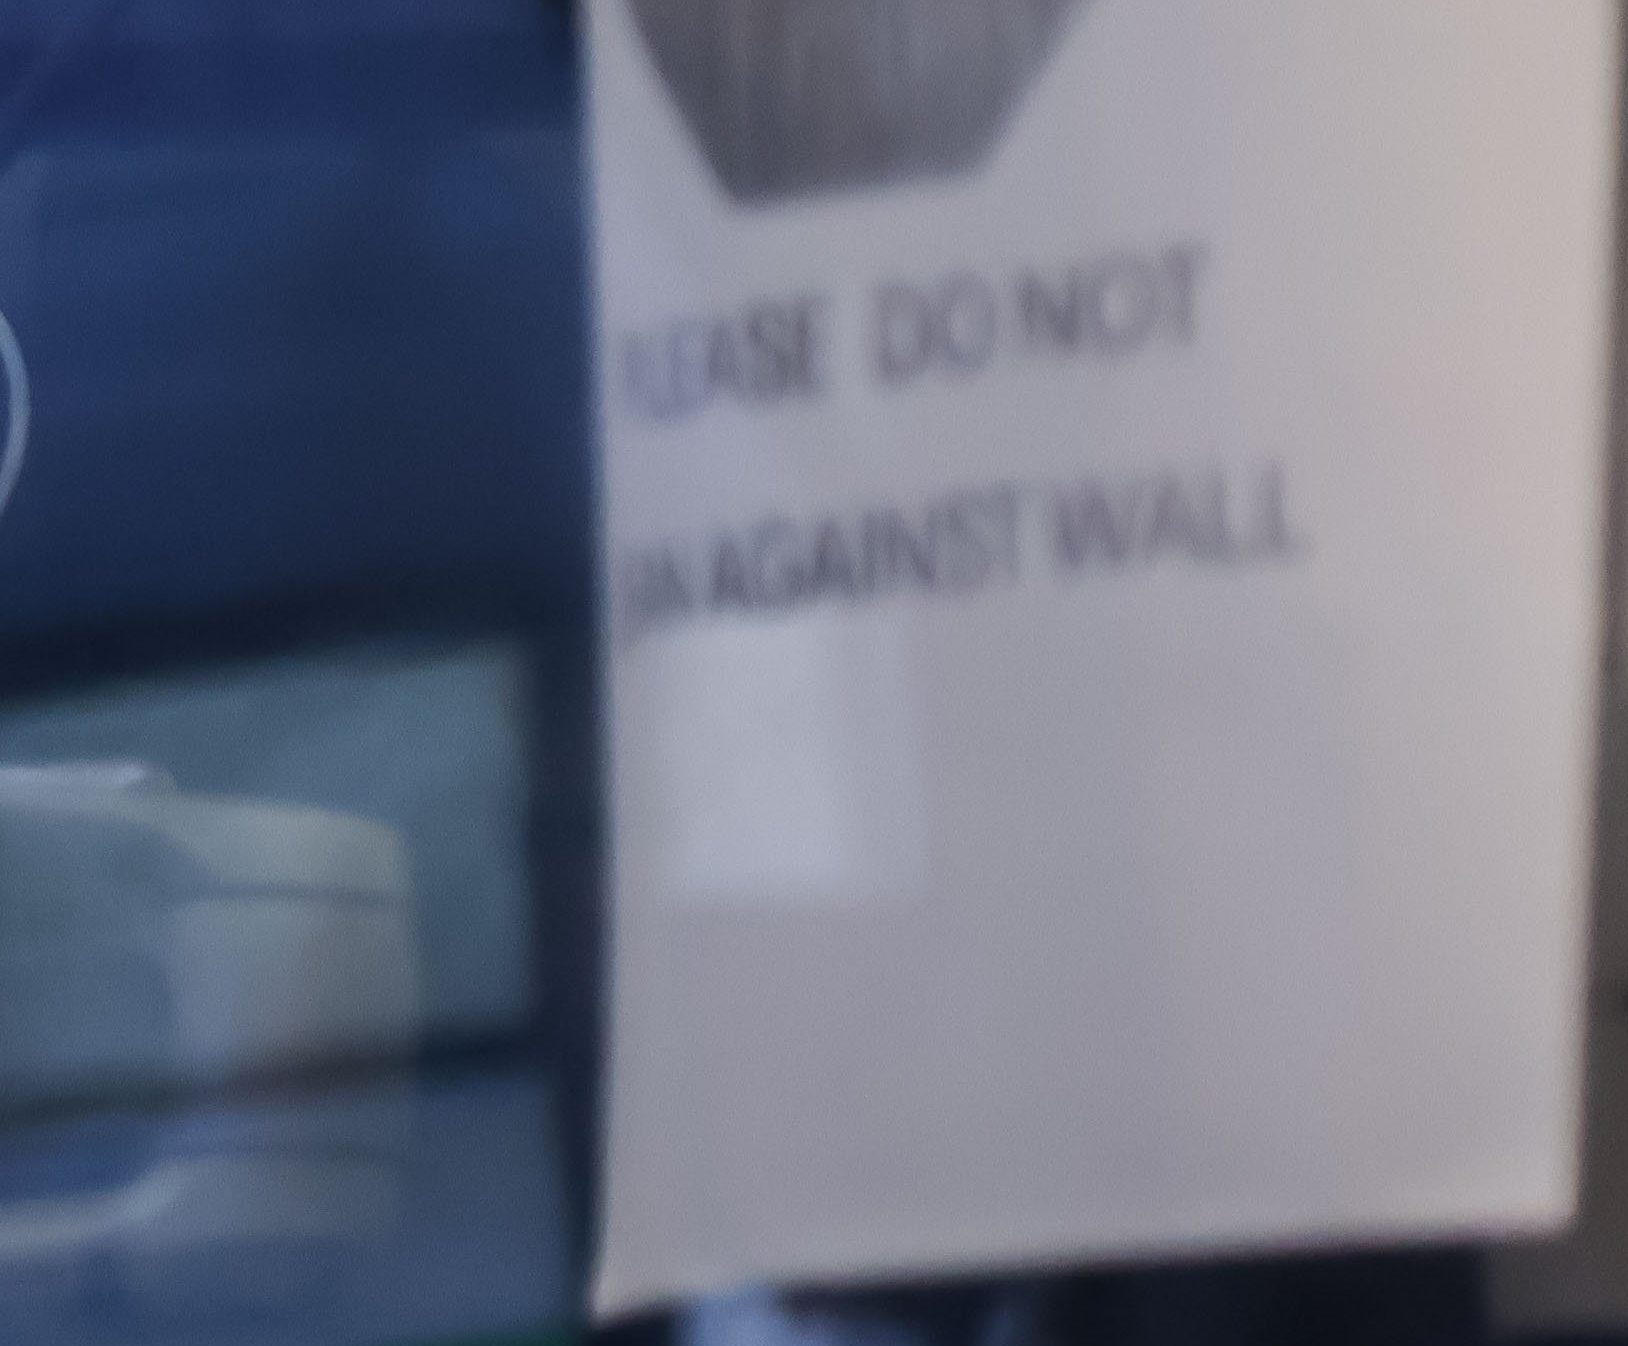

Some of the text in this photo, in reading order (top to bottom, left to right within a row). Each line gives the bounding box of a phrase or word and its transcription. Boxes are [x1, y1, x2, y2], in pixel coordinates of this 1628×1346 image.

[618, 242, 1208, 424] LEASE DO NOT
[706, 480, 1022, 616] AGAINST
[1050, 459, 1308, 580] WALL
